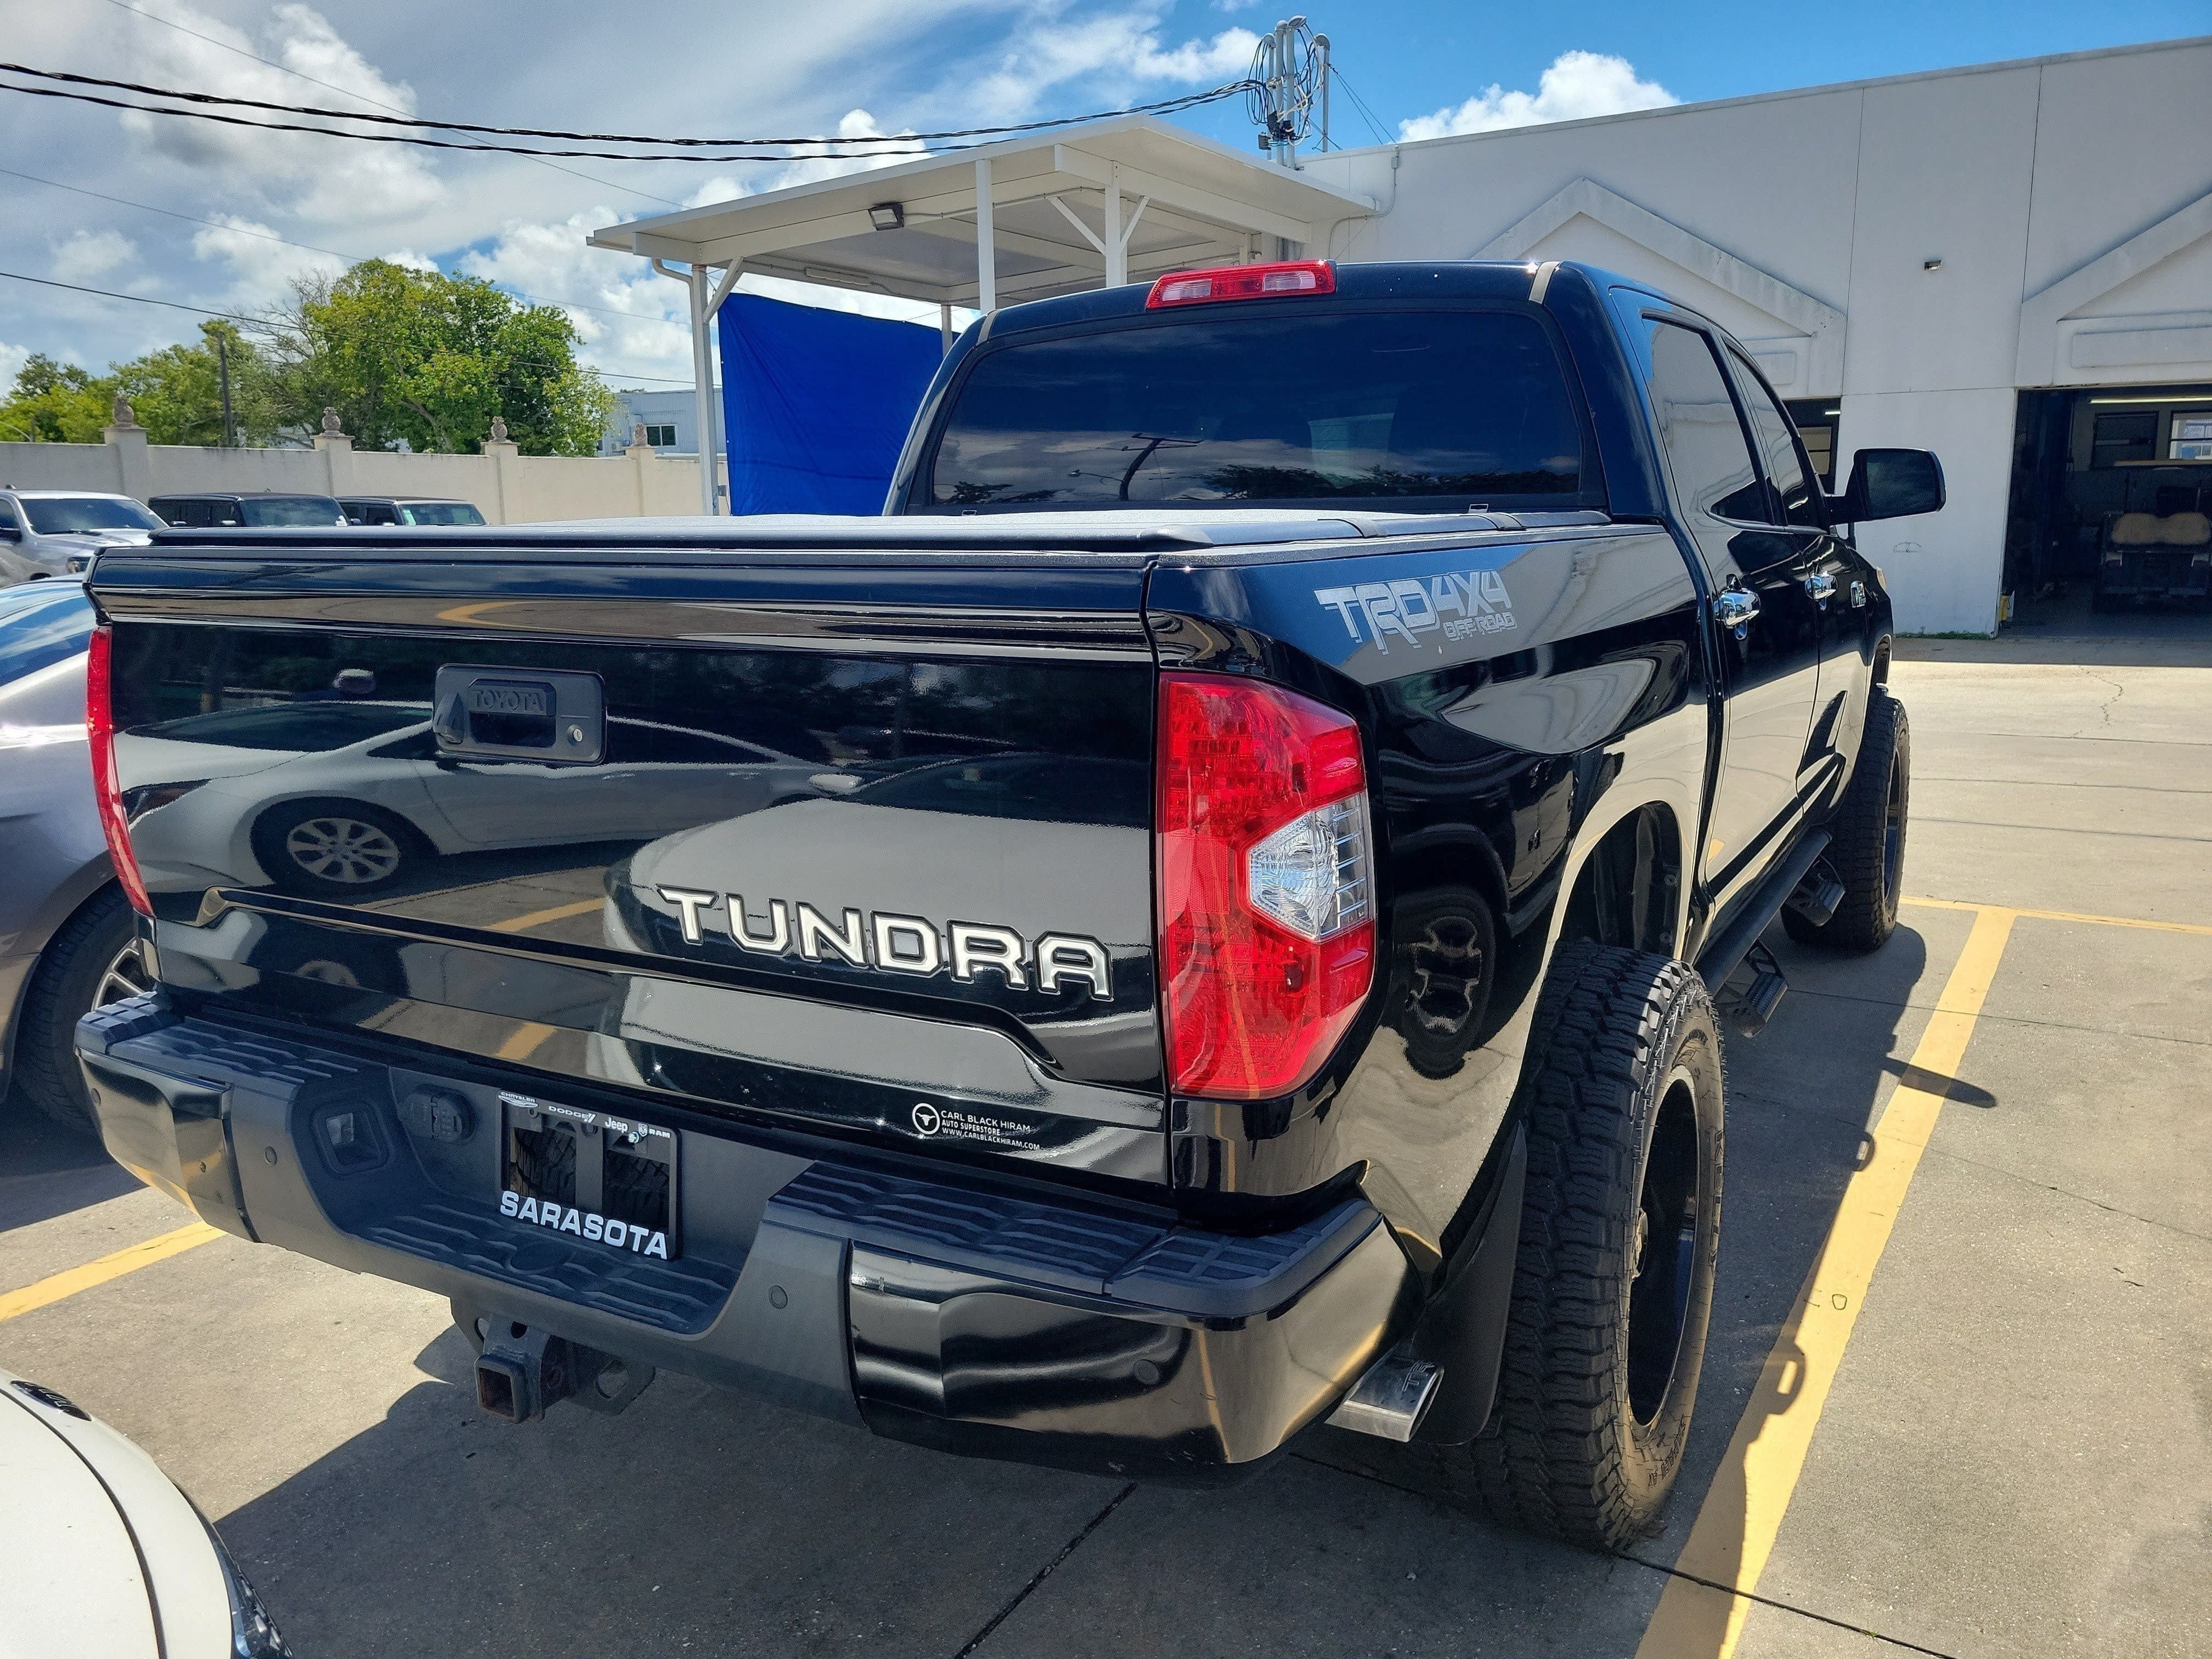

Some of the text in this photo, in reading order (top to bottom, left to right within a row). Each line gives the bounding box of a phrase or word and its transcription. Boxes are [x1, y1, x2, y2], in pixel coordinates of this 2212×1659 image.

[1313, 579, 1440, 656] TRD
[1443, 612, 1517, 642] OFF ROAD
[475, 689, 545, 712] TOYOTA
[655, 883, 1115, 1003] TUNDRA
[501, 1092, 536, 1103] CHRYSLER
[549, 1105, 590, 1120] DODGE
[941, 1110, 1031, 1132] CARL BLACK HIRAM
[605, 1117, 629, 1133] Jeep
[649, 1128, 670, 1138] RAM
[941, 1120, 1001, 1136] AUTO SUPERSTORE
[942, 1127, 1041, 1151] WWW.CARLBLACKHIRAM.COM
[500, 1190, 668, 1260] SARASOTA
